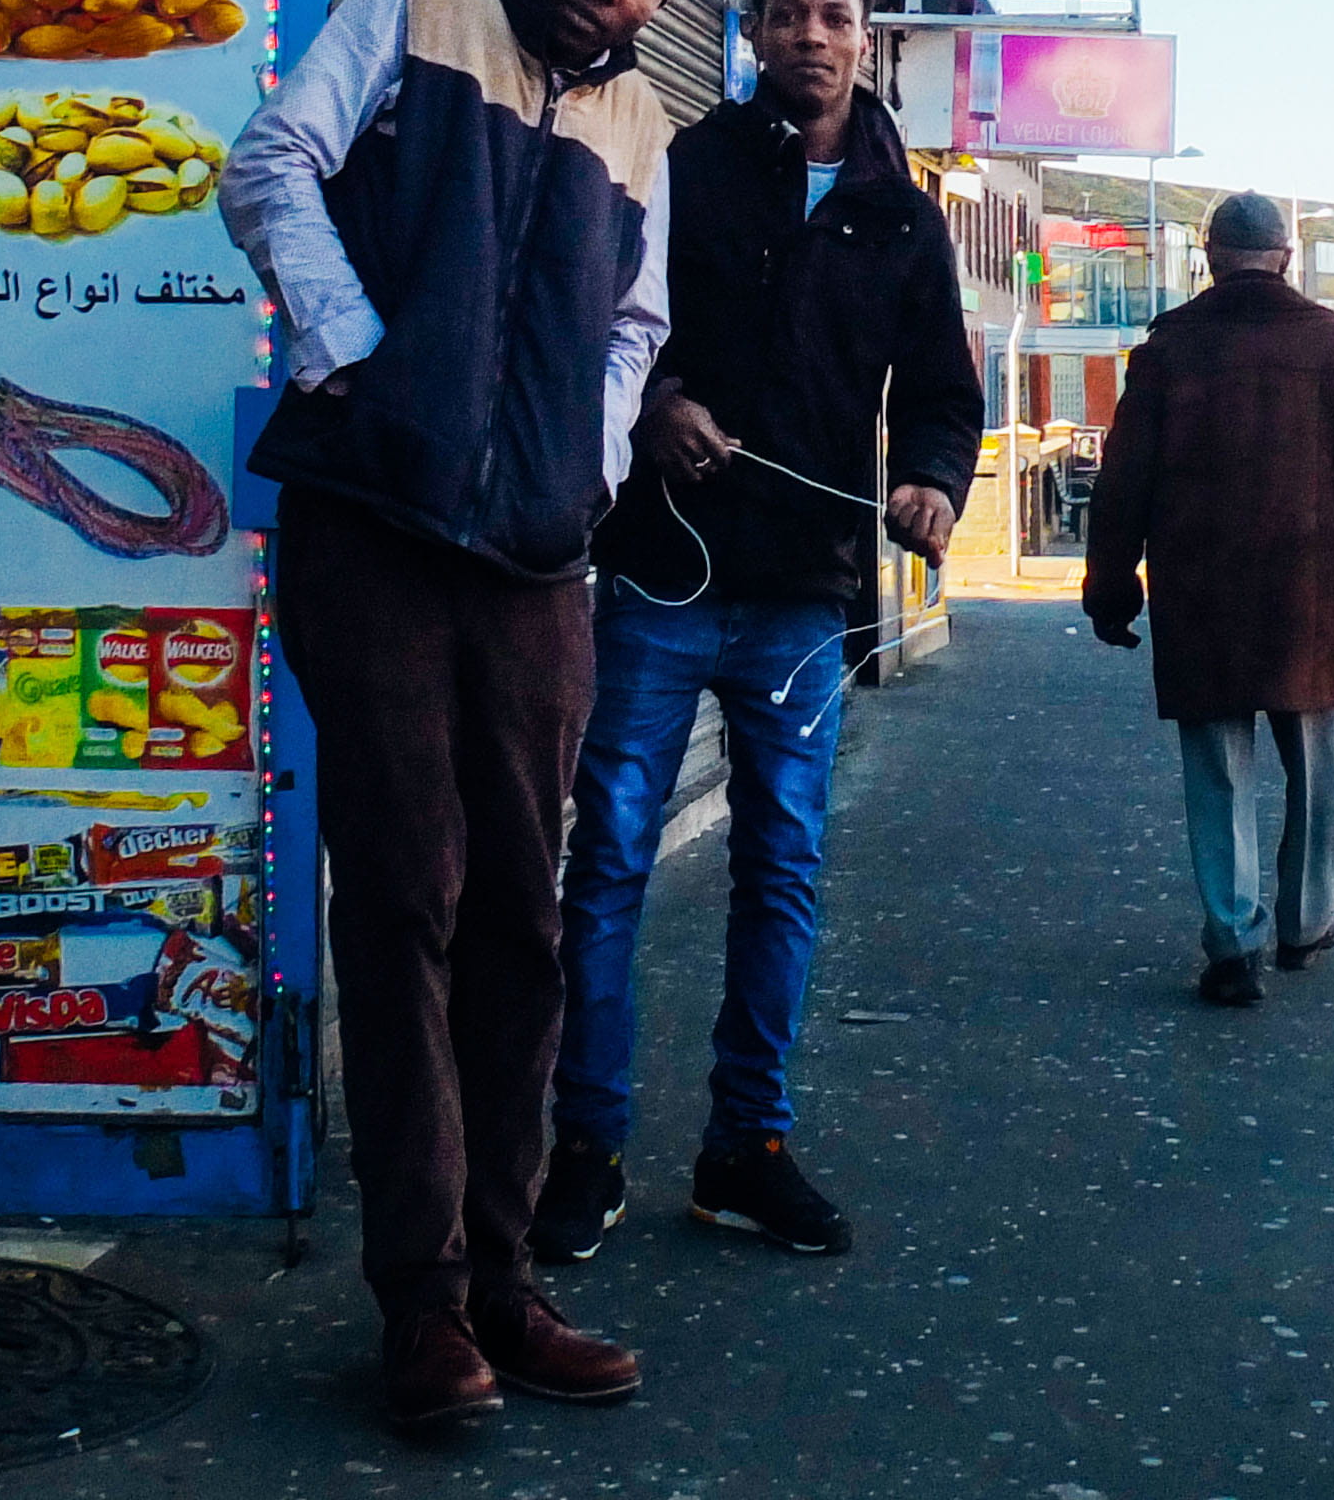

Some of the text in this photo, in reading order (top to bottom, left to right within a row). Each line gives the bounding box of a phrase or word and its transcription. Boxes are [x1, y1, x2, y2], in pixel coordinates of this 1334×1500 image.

[1013, 122, 1075, 142] VELVET
[34, 271, 119, 319] انواع
[135, 270, 246, 305] مختلف
[167, 639, 234, 661] WALKERS
